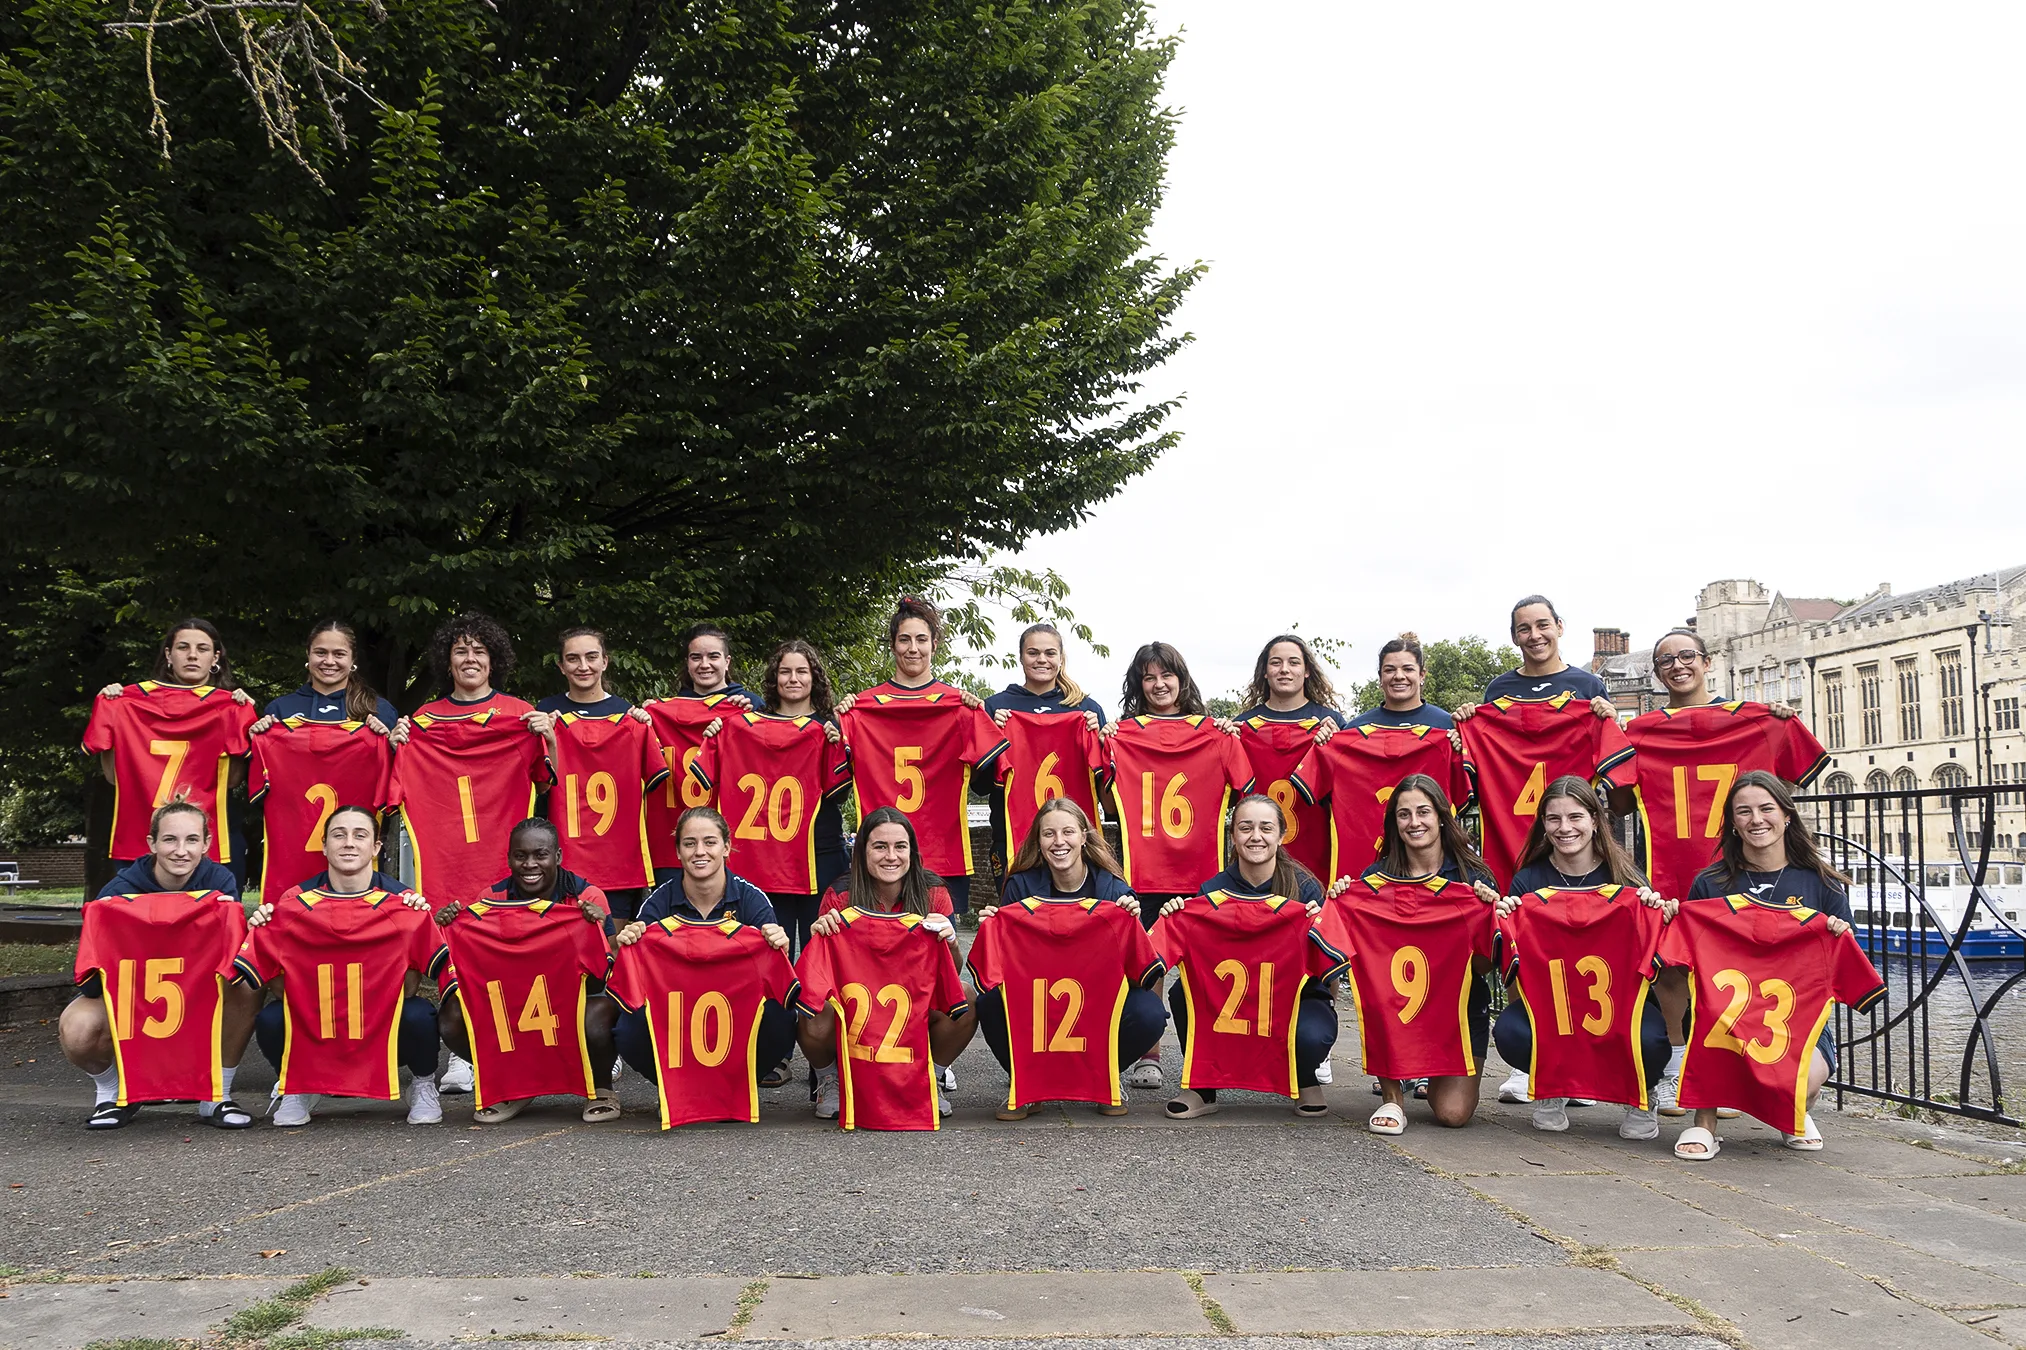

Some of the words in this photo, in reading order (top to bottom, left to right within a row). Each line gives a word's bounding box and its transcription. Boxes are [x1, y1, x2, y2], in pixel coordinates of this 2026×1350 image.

[150, 740, 190, 809] 7
[457, 775, 480, 843] 1
[565, 771, 619, 838] 19
[664, 746, 713, 809] 18
[735, 774, 804, 842] 20
[894, 746, 926, 813] 5
[1034, 752, 1065, 810] 6
[1142, 771, 1193, 839] 16
[1513, 762, 1547, 818] 4
[1673, 763, 1738, 839] 17
[305, 783, 339, 852] 2
[1267, 779, 1300, 845] 8
[116, 957, 186, 1040] 15
[317, 962, 364, 1040] 11
[486, 974, 560, 1053] 14
[1032, 977, 1087, 1053] 12
[1213, 959, 1275, 1038] 21
[1391, 945, 1431, 1024] 9
[1548, 955, 1615, 1037] 13
[1703, 968, 1797, 1065] 23
[668, 991, 734, 1069] 10
[840, 982, 914, 1064] 22
